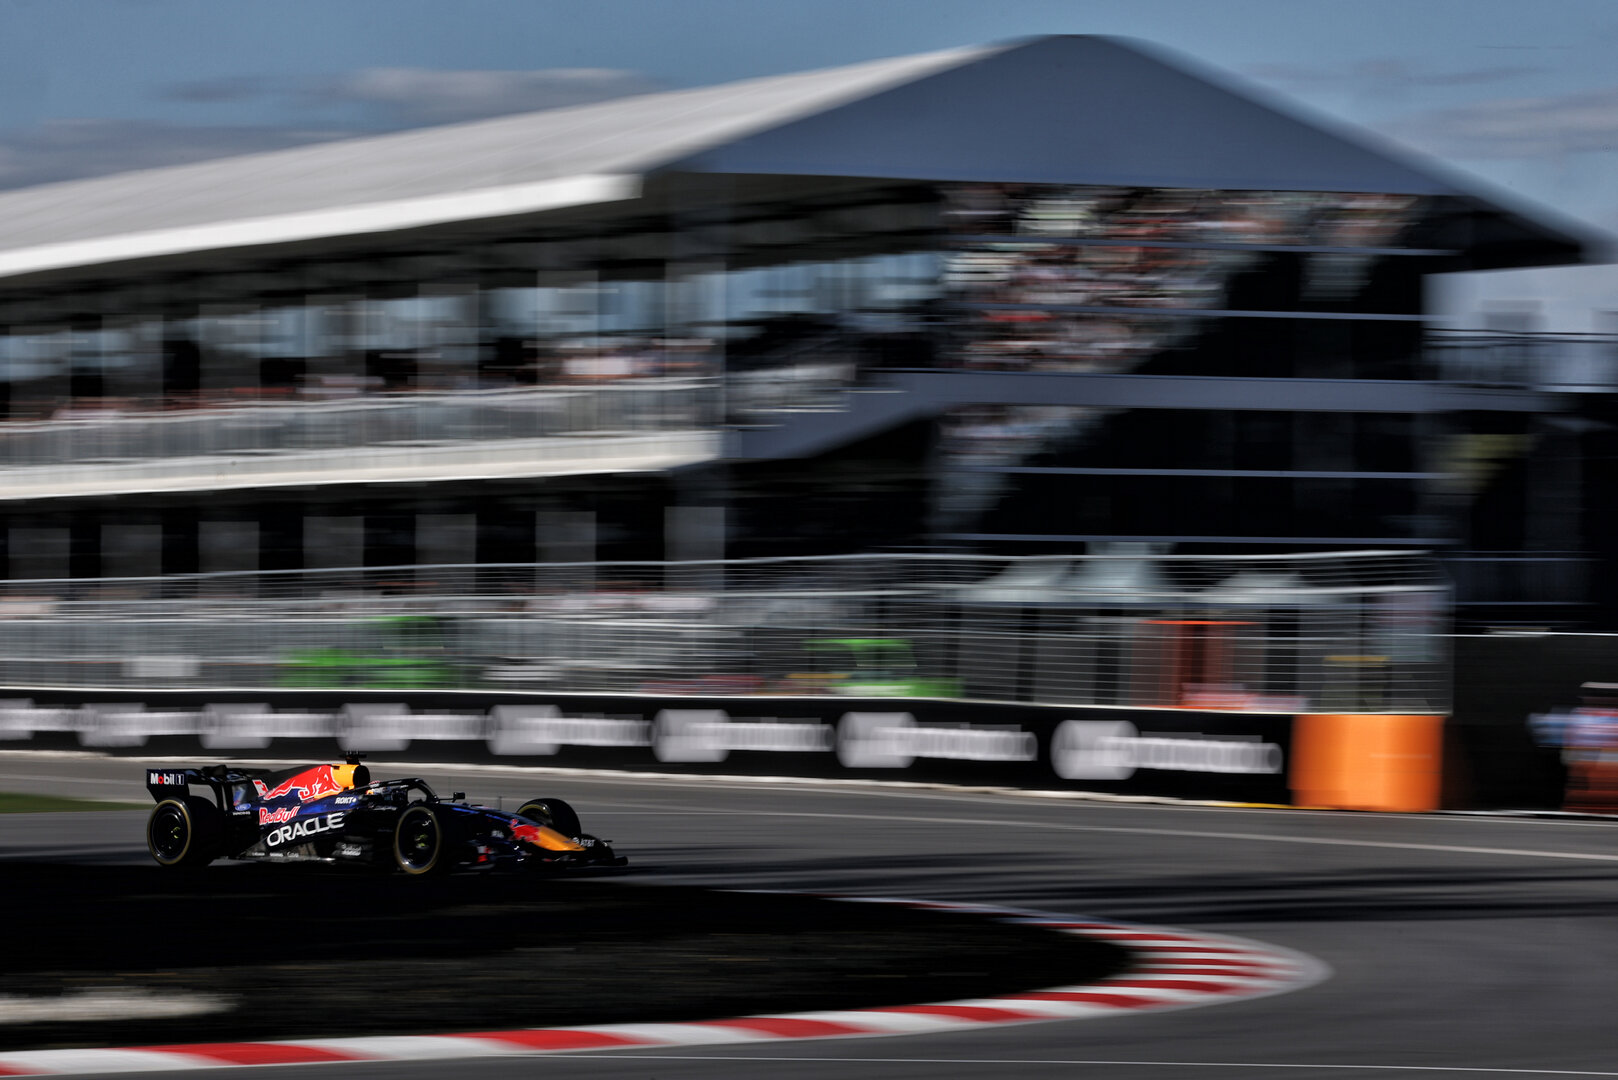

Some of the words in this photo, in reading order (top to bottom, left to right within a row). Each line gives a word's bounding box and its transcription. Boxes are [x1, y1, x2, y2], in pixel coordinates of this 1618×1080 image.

[150, 772, 175, 785] Mobil
[259, 807, 279, 826] Red
[275, 805, 301, 824] Bull
[266, 811, 346, 847] ORACLE
